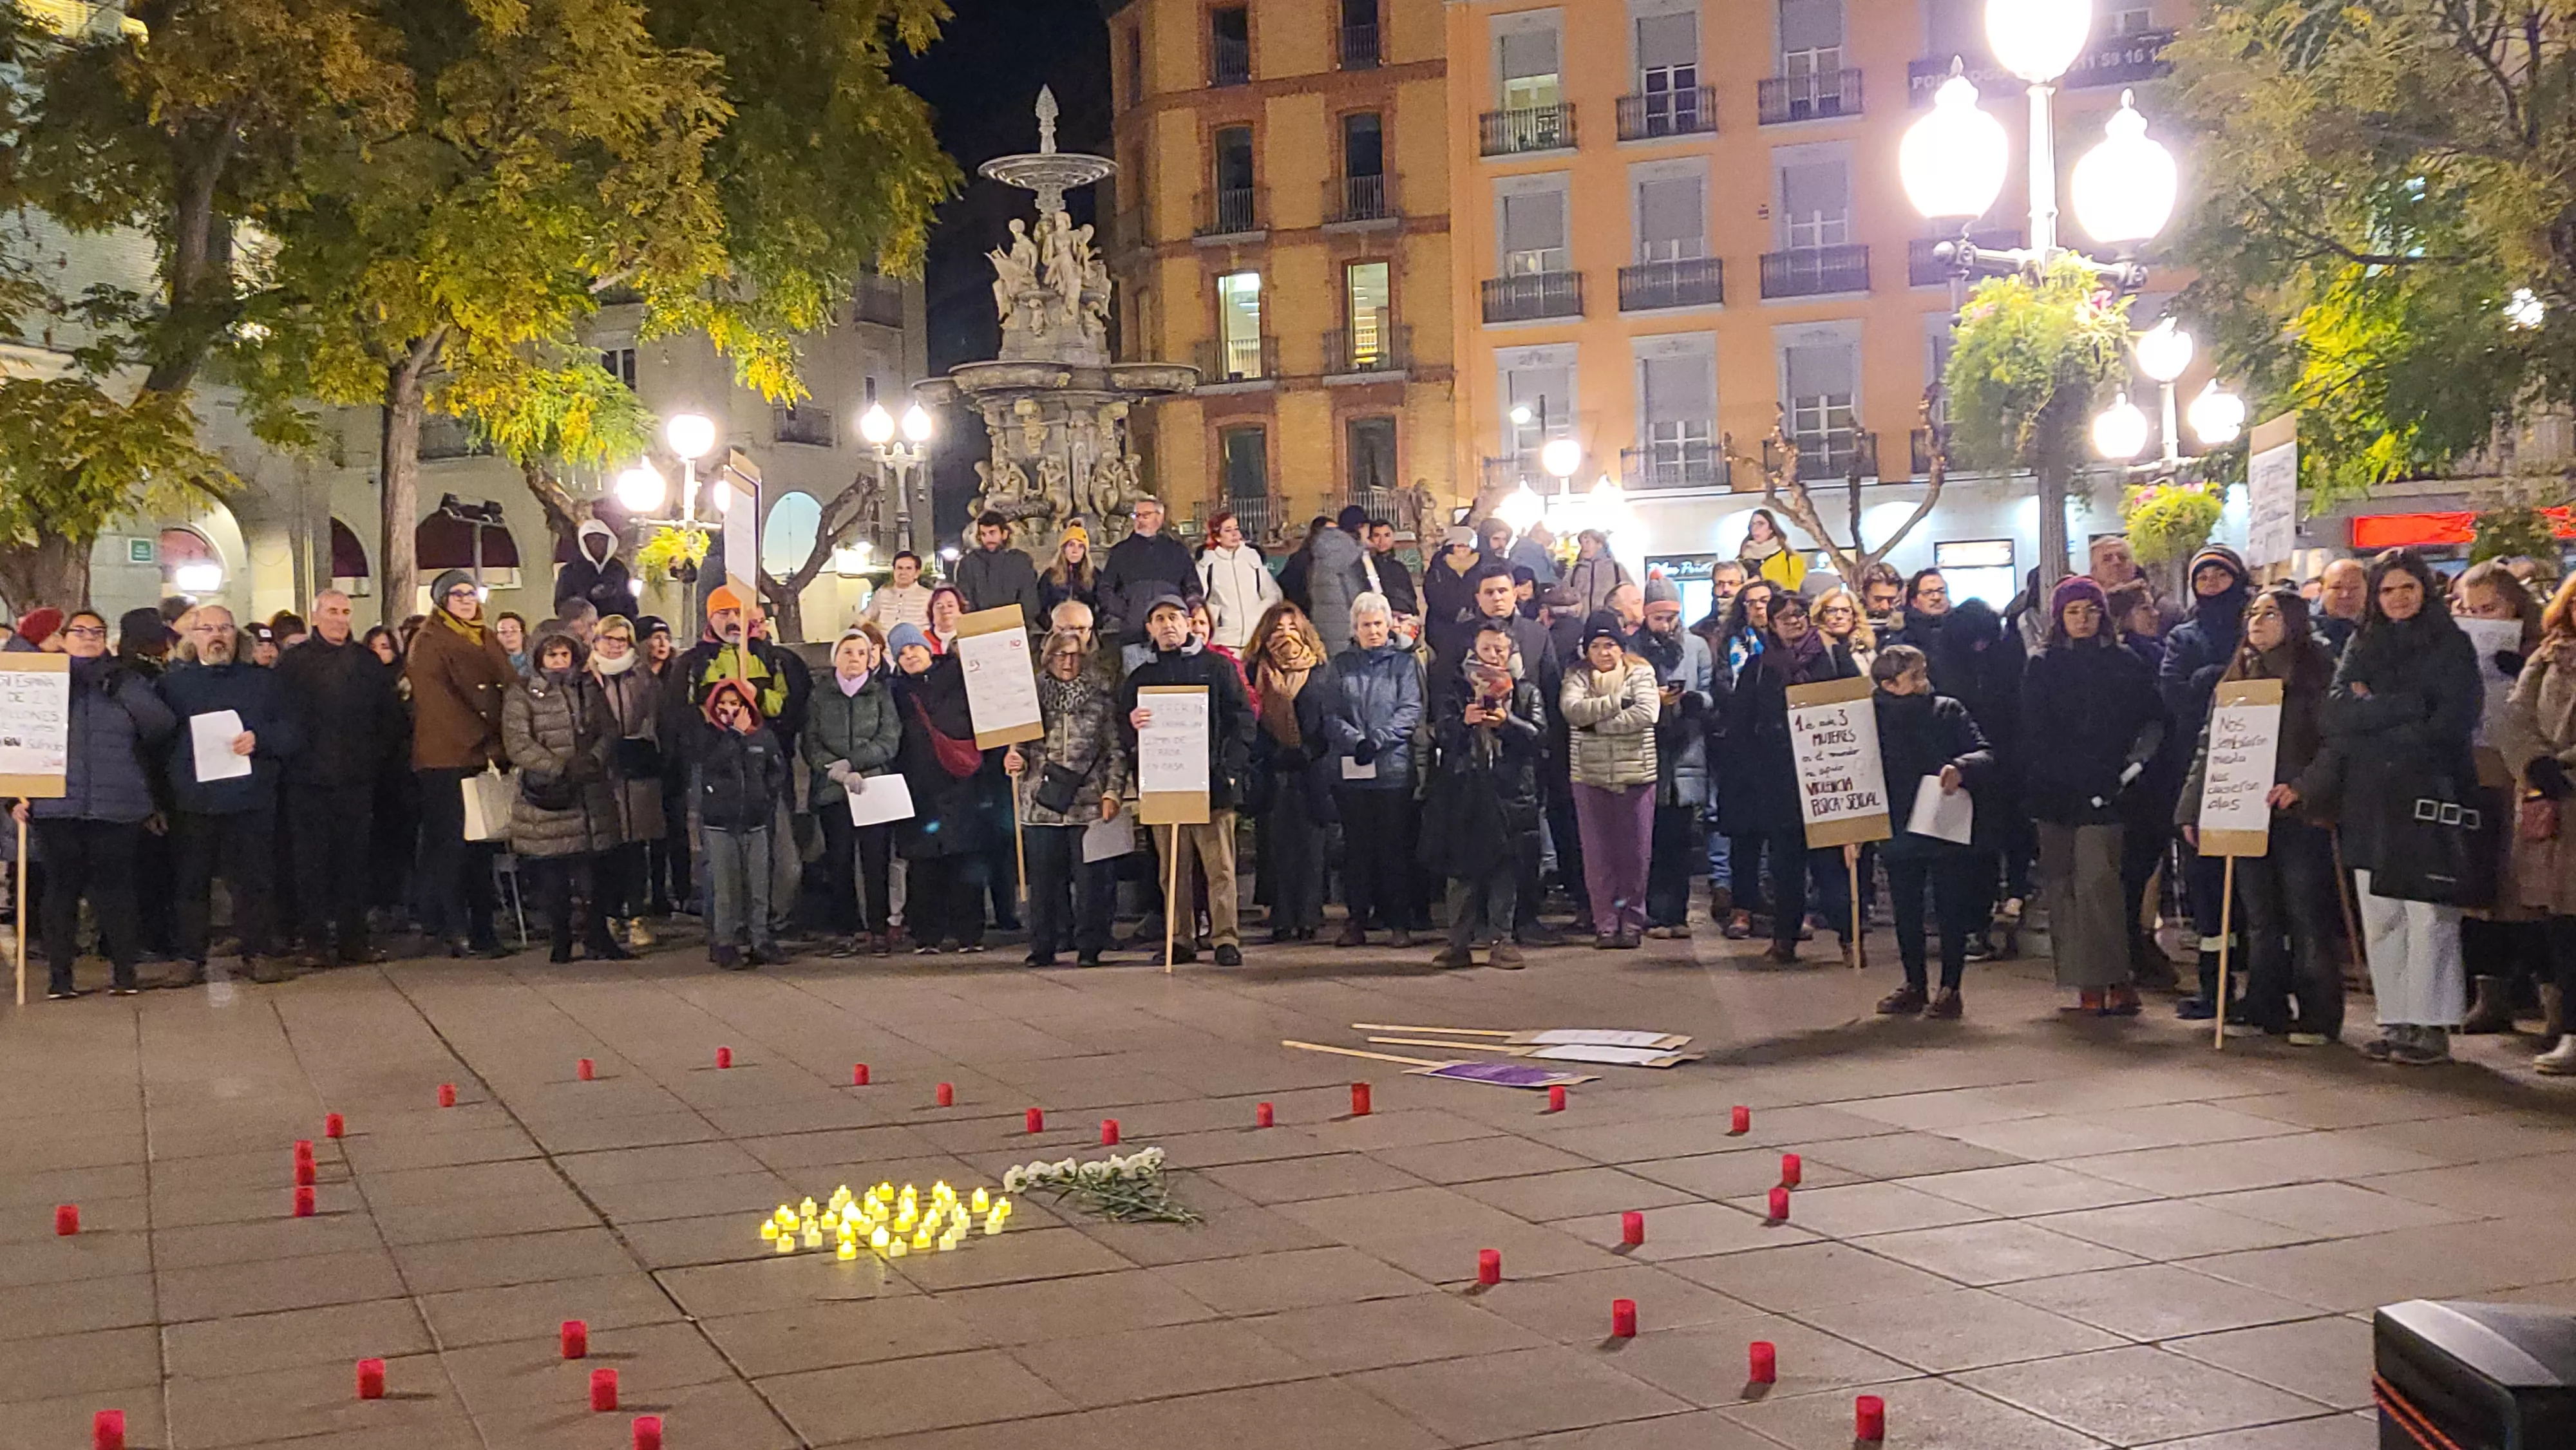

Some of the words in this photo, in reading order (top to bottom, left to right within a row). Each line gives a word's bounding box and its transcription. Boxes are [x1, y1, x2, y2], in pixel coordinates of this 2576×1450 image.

[1795, 715, 1804, 731] 1
[1837, 709, 1848, 726] 3
[1812, 728, 1857, 746] MUJERES
[1805, 776, 1853, 796] VIOLENCIA
